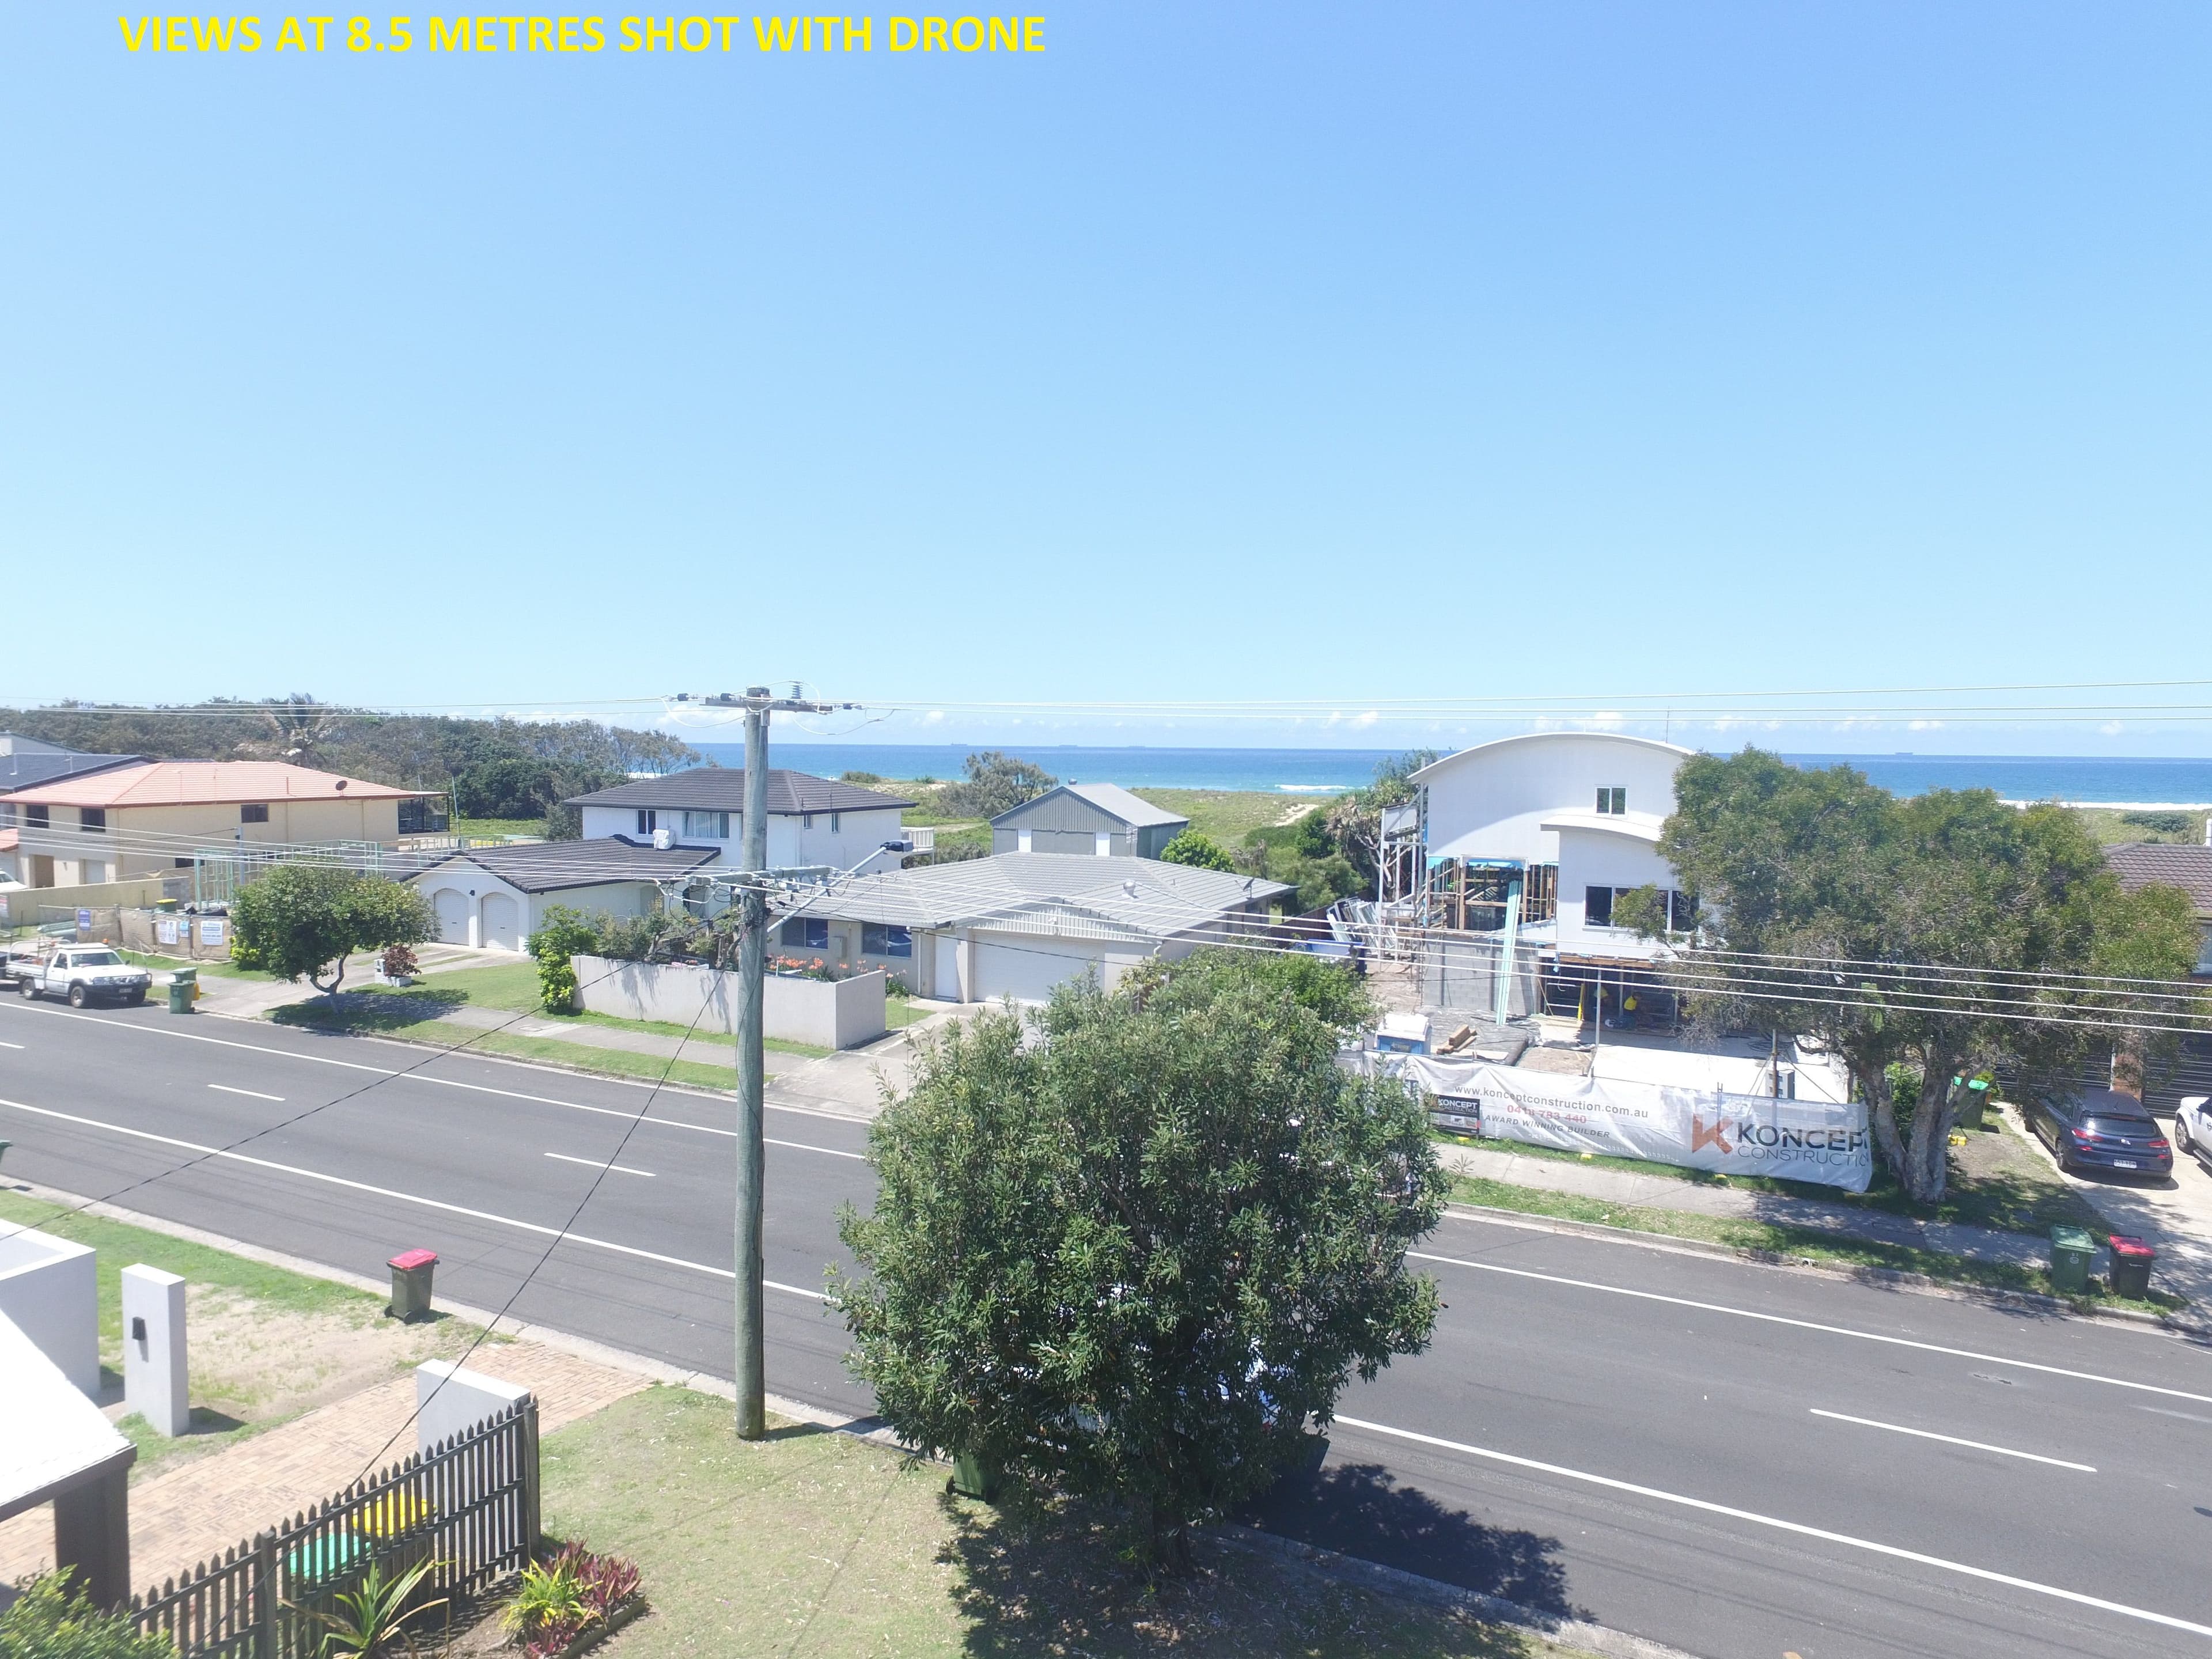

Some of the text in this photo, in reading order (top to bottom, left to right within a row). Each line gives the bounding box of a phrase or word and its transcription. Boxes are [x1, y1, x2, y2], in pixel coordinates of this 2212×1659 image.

[1438, 1098, 1478, 1109] KONCEPT
[1455, 1085, 1649, 1118] www.konceptconstruction.com.au
[1484, 1114, 1610, 1138] AWARD WINNING BUILDER
[1565, 1113, 1587, 1124] 440
